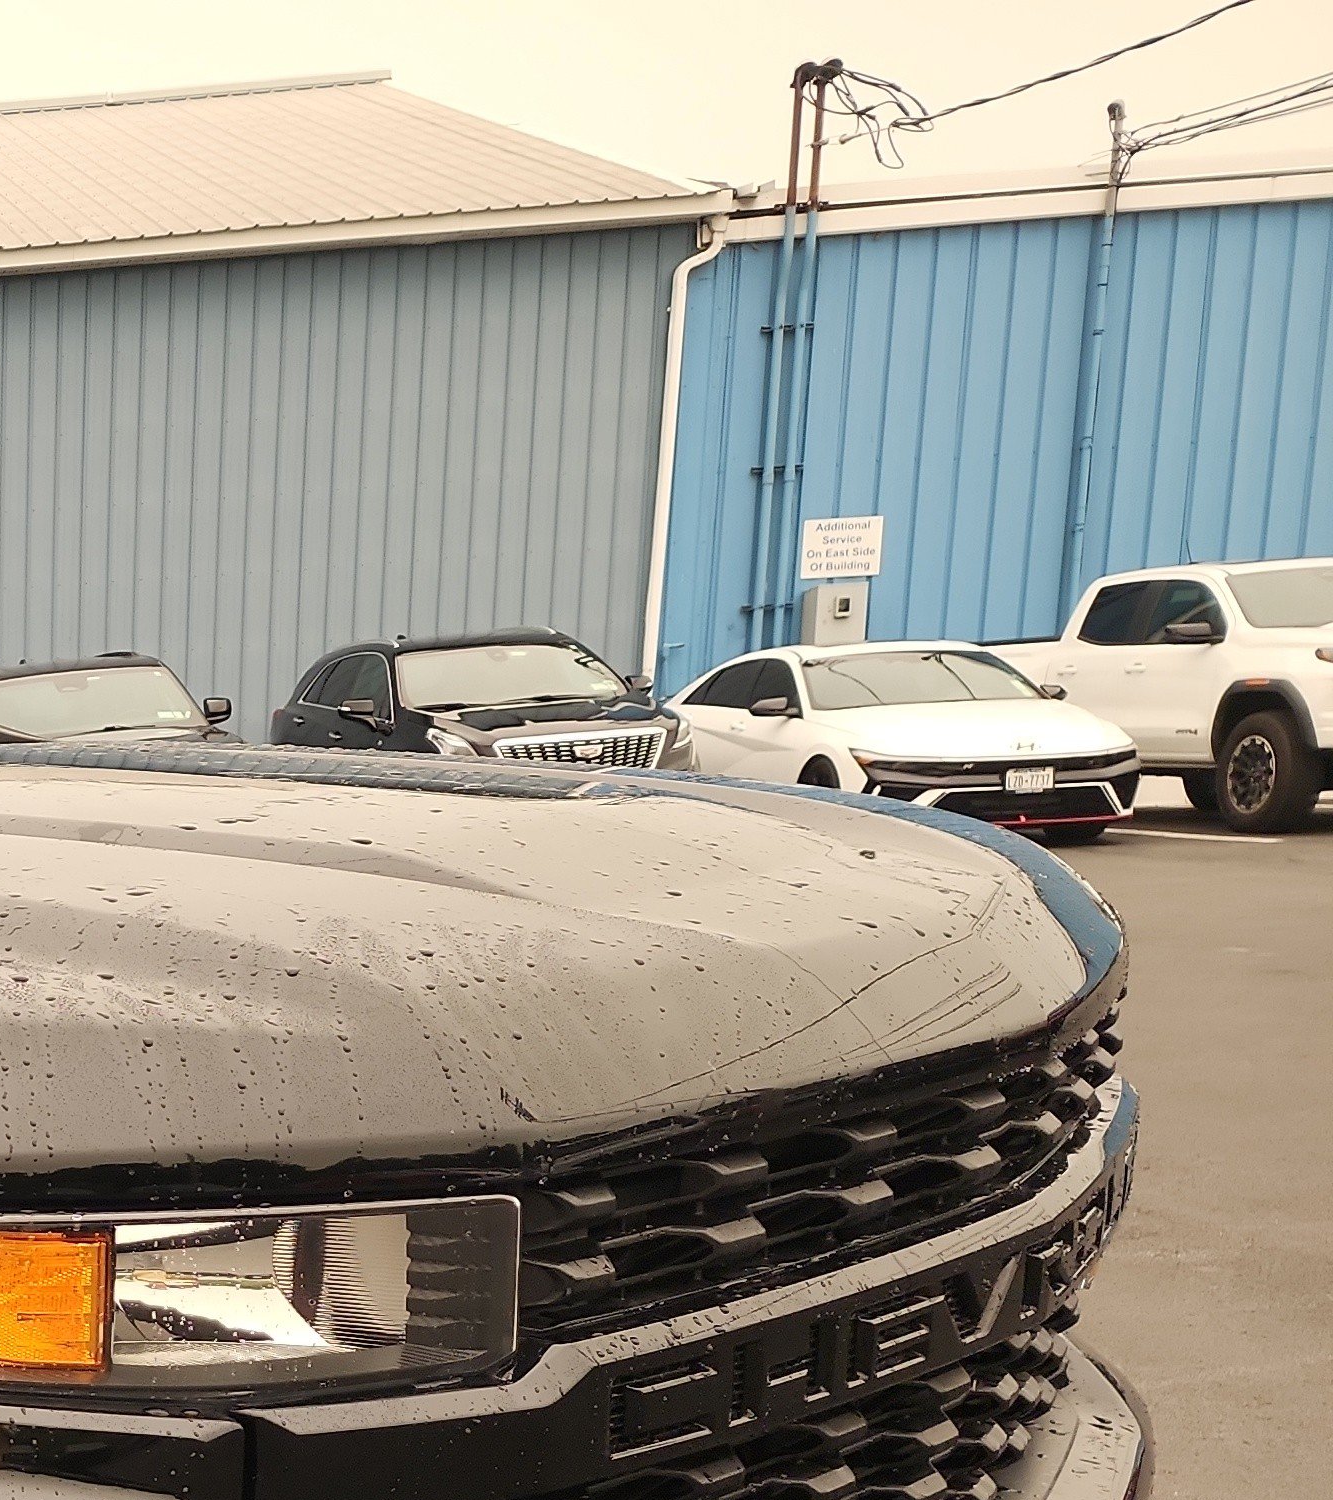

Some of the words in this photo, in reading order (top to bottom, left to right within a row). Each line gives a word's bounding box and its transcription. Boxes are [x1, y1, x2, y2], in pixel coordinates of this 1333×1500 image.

[815, 521, 871, 532] Additional
[822, 535, 862, 545] Service
[806, 549, 822, 559] On
[825, 548, 850, 558] East
[852, 547, 876, 557] Side
[810, 562, 823, 571] Of
[825, 561, 871, 571] Building
